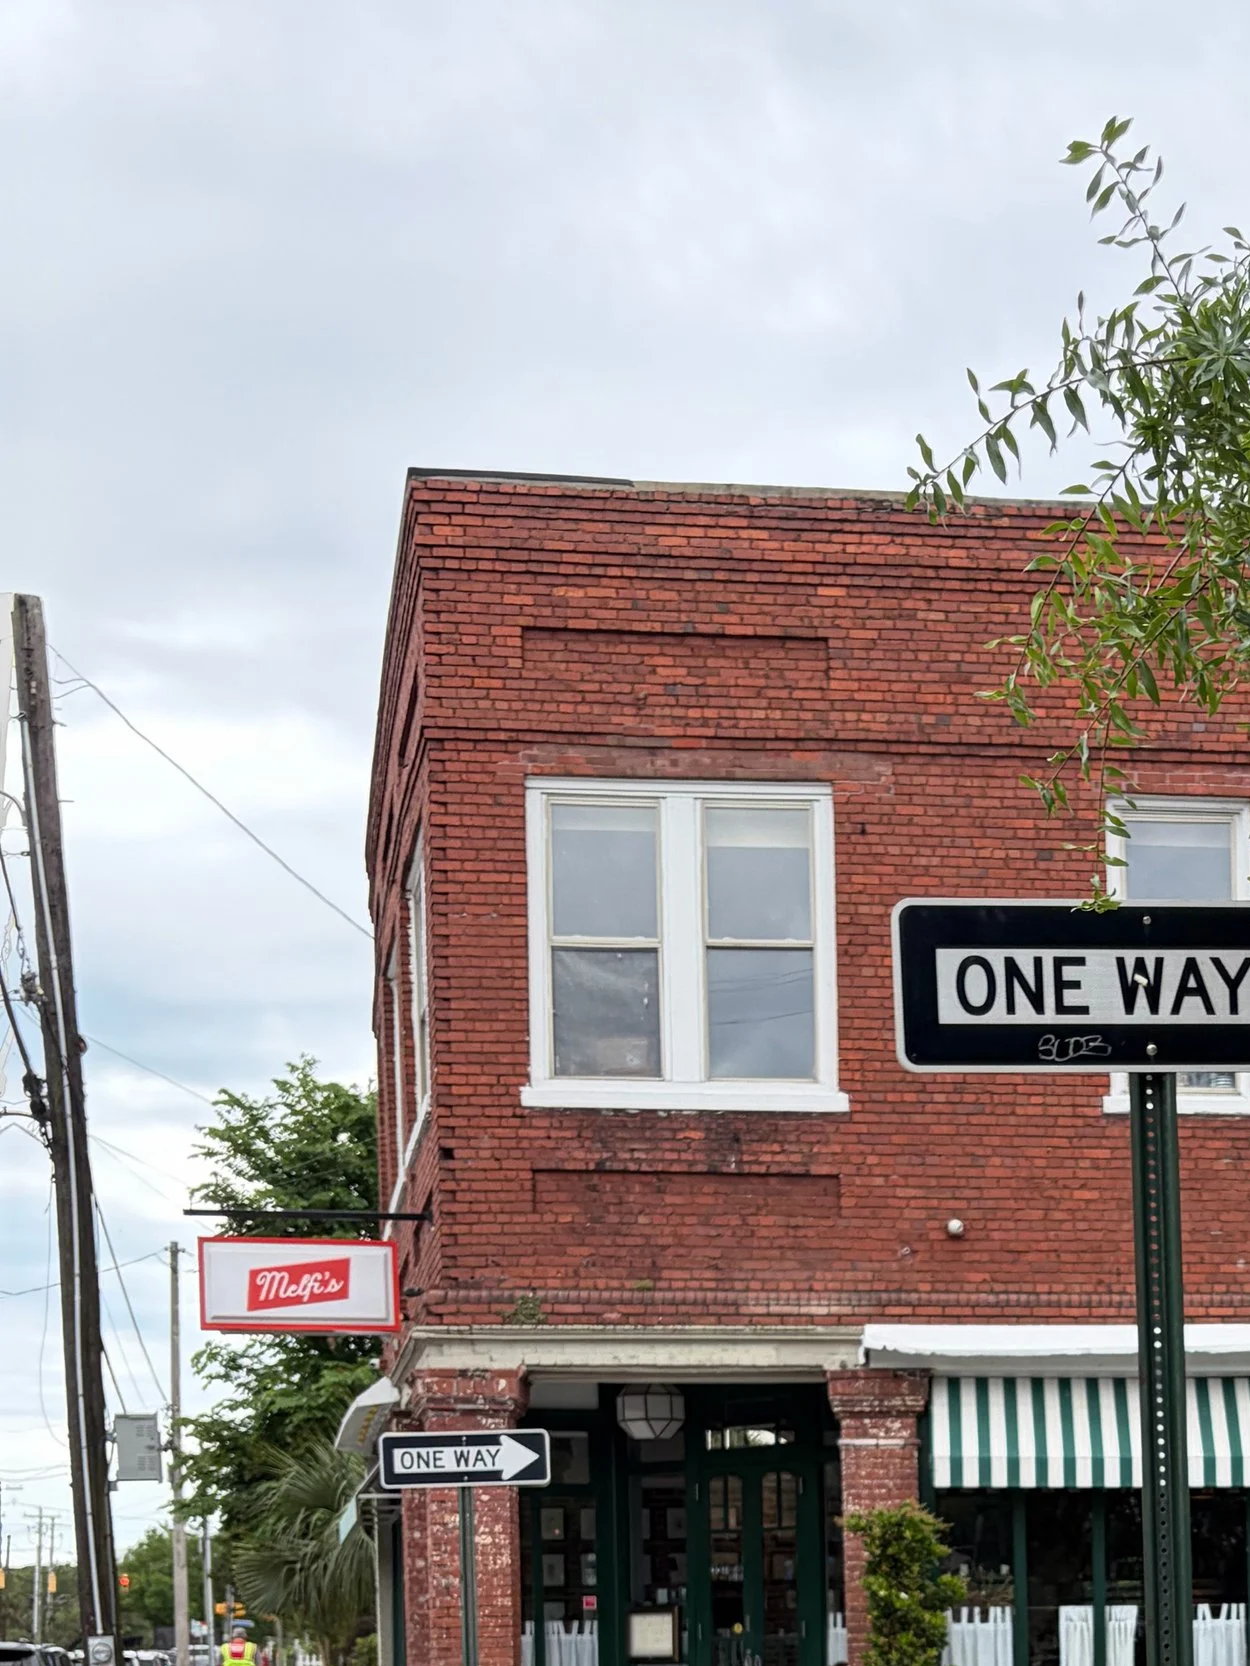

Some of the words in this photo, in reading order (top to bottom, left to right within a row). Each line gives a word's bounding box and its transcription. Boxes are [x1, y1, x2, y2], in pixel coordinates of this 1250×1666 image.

[955, 955, 1090, 1016] ONE
[255, 1270, 345, 1303] Melfi's
[400, 1450, 446, 1470] ONE
[453, 1448, 501, 1468] WAY
